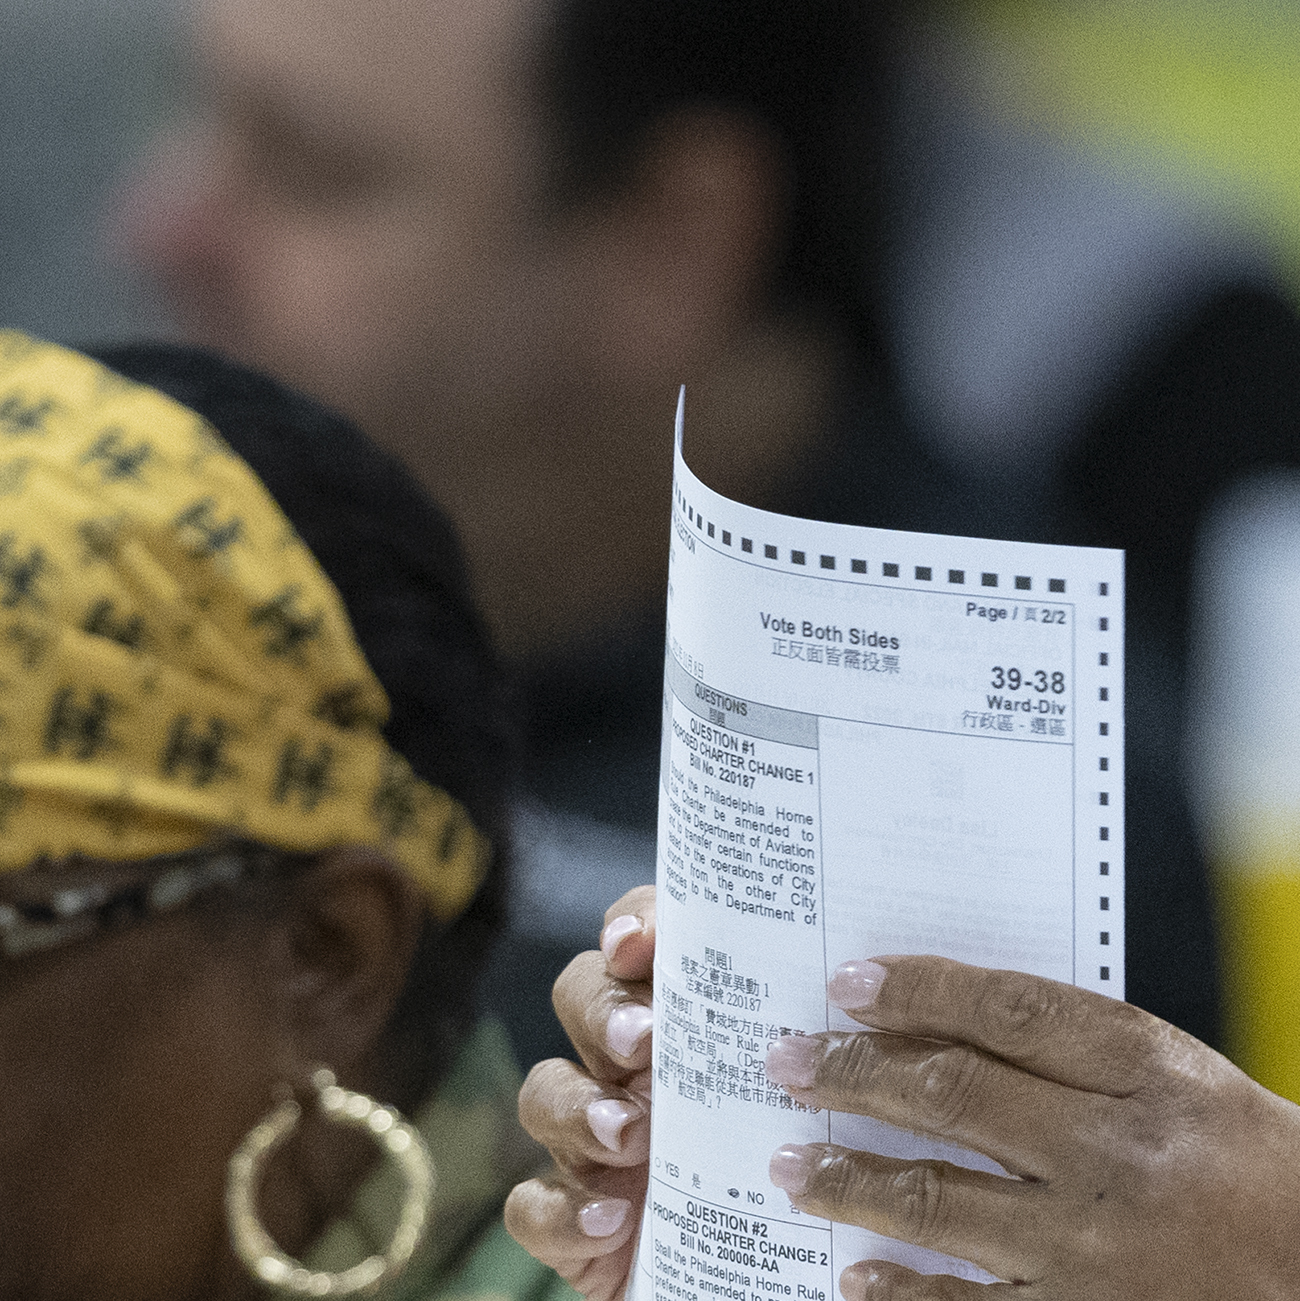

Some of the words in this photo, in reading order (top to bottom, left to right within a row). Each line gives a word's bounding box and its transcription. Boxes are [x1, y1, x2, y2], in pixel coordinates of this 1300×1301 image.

[760, 612, 795, 635] Vote
[802, 621, 843, 643] Both
[849, 628, 899, 650] Sides
[966, 602, 1007, 622] Page
[1042, 609, 1066, 624] 2/2
[695, 683, 747, 716] QUESTIONS
[991, 666, 1065, 694] 39-38
[962, 710, 1014, 732] 行政區
[987, 694, 1066, 715] Ward-Div
[690, 718, 738, 751] QUESTION
[742, 740, 755, 756] #1
[700, 742, 745, 770] CHARTER
[748, 759, 803, 783] CHANGE
[808, 772, 814, 785] 1
[703, 761, 716, 778] No.
[719, 767, 755, 789] 220187
[682, 790, 706, 814] Charter
[714, 806, 725, 821] be
[735, 816, 790, 838] amended
[802, 830, 814, 842] to
[688, 778, 698, 793] the
[704, 785, 764, 815] Philadelphia
[776, 806, 813, 825] Home
[685, 827, 712, 851] transfer
[717, 844, 752, 863] certain
[760, 853, 815, 875] functions
[694, 814, 745, 845] Department
[750, 836, 761, 848] of
[765, 839, 815, 859] Aviation
[690, 863, 708, 883] from
[718, 875, 734, 891] the
[746, 885, 777, 901] other
[791, 893, 816, 911] City
[694, 849, 705, 864] the
[711, 857, 764, 882] operations
[772, 874, 783, 886] of
[792, 876, 816, 894] City
[692, 881, 699, 895] to
[704, 887, 718, 903] the
[726, 894, 795, 922] Department
[804, 913, 817, 925] of
[727, 993, 761, 1012] 220187
[764, 983, 770, 998] 1
[705, 1025, 730, 1045] Home
[737, 1035, 759, 1052] Rule
[665, 1160, 680, 1178] YES
[692, 1173, 701, 1189] 是
[747, 1190, 765, 1205] NO
[653, 1201, 698, 1234] PROPOSED
[702, 1225, 755, 1252] CHARTER
[759, 1240, 816, 1264] CHANGE
[820, 1252, 828, 1266] 2
[687, 1201, 748, 1233] QUESTION
[752, 1222, 768, 1238] #2
[680, 1232, 694, 1250] Bill
[697, 1240, 714, 1256] No.
[717, 1246, 779, 1274] 200006-AA
[655, 1256, 680, 1279] Charter
[685, 1271, 694, 1286] be
[699, 1278, 746, 1301] amended
[674, 1248, 686, 1266] the
[691, 1256, 750, 1287] Philadelphia
[756, 1276, 792, 1296] Home
[797, 1284, 826, 1301] Rule
